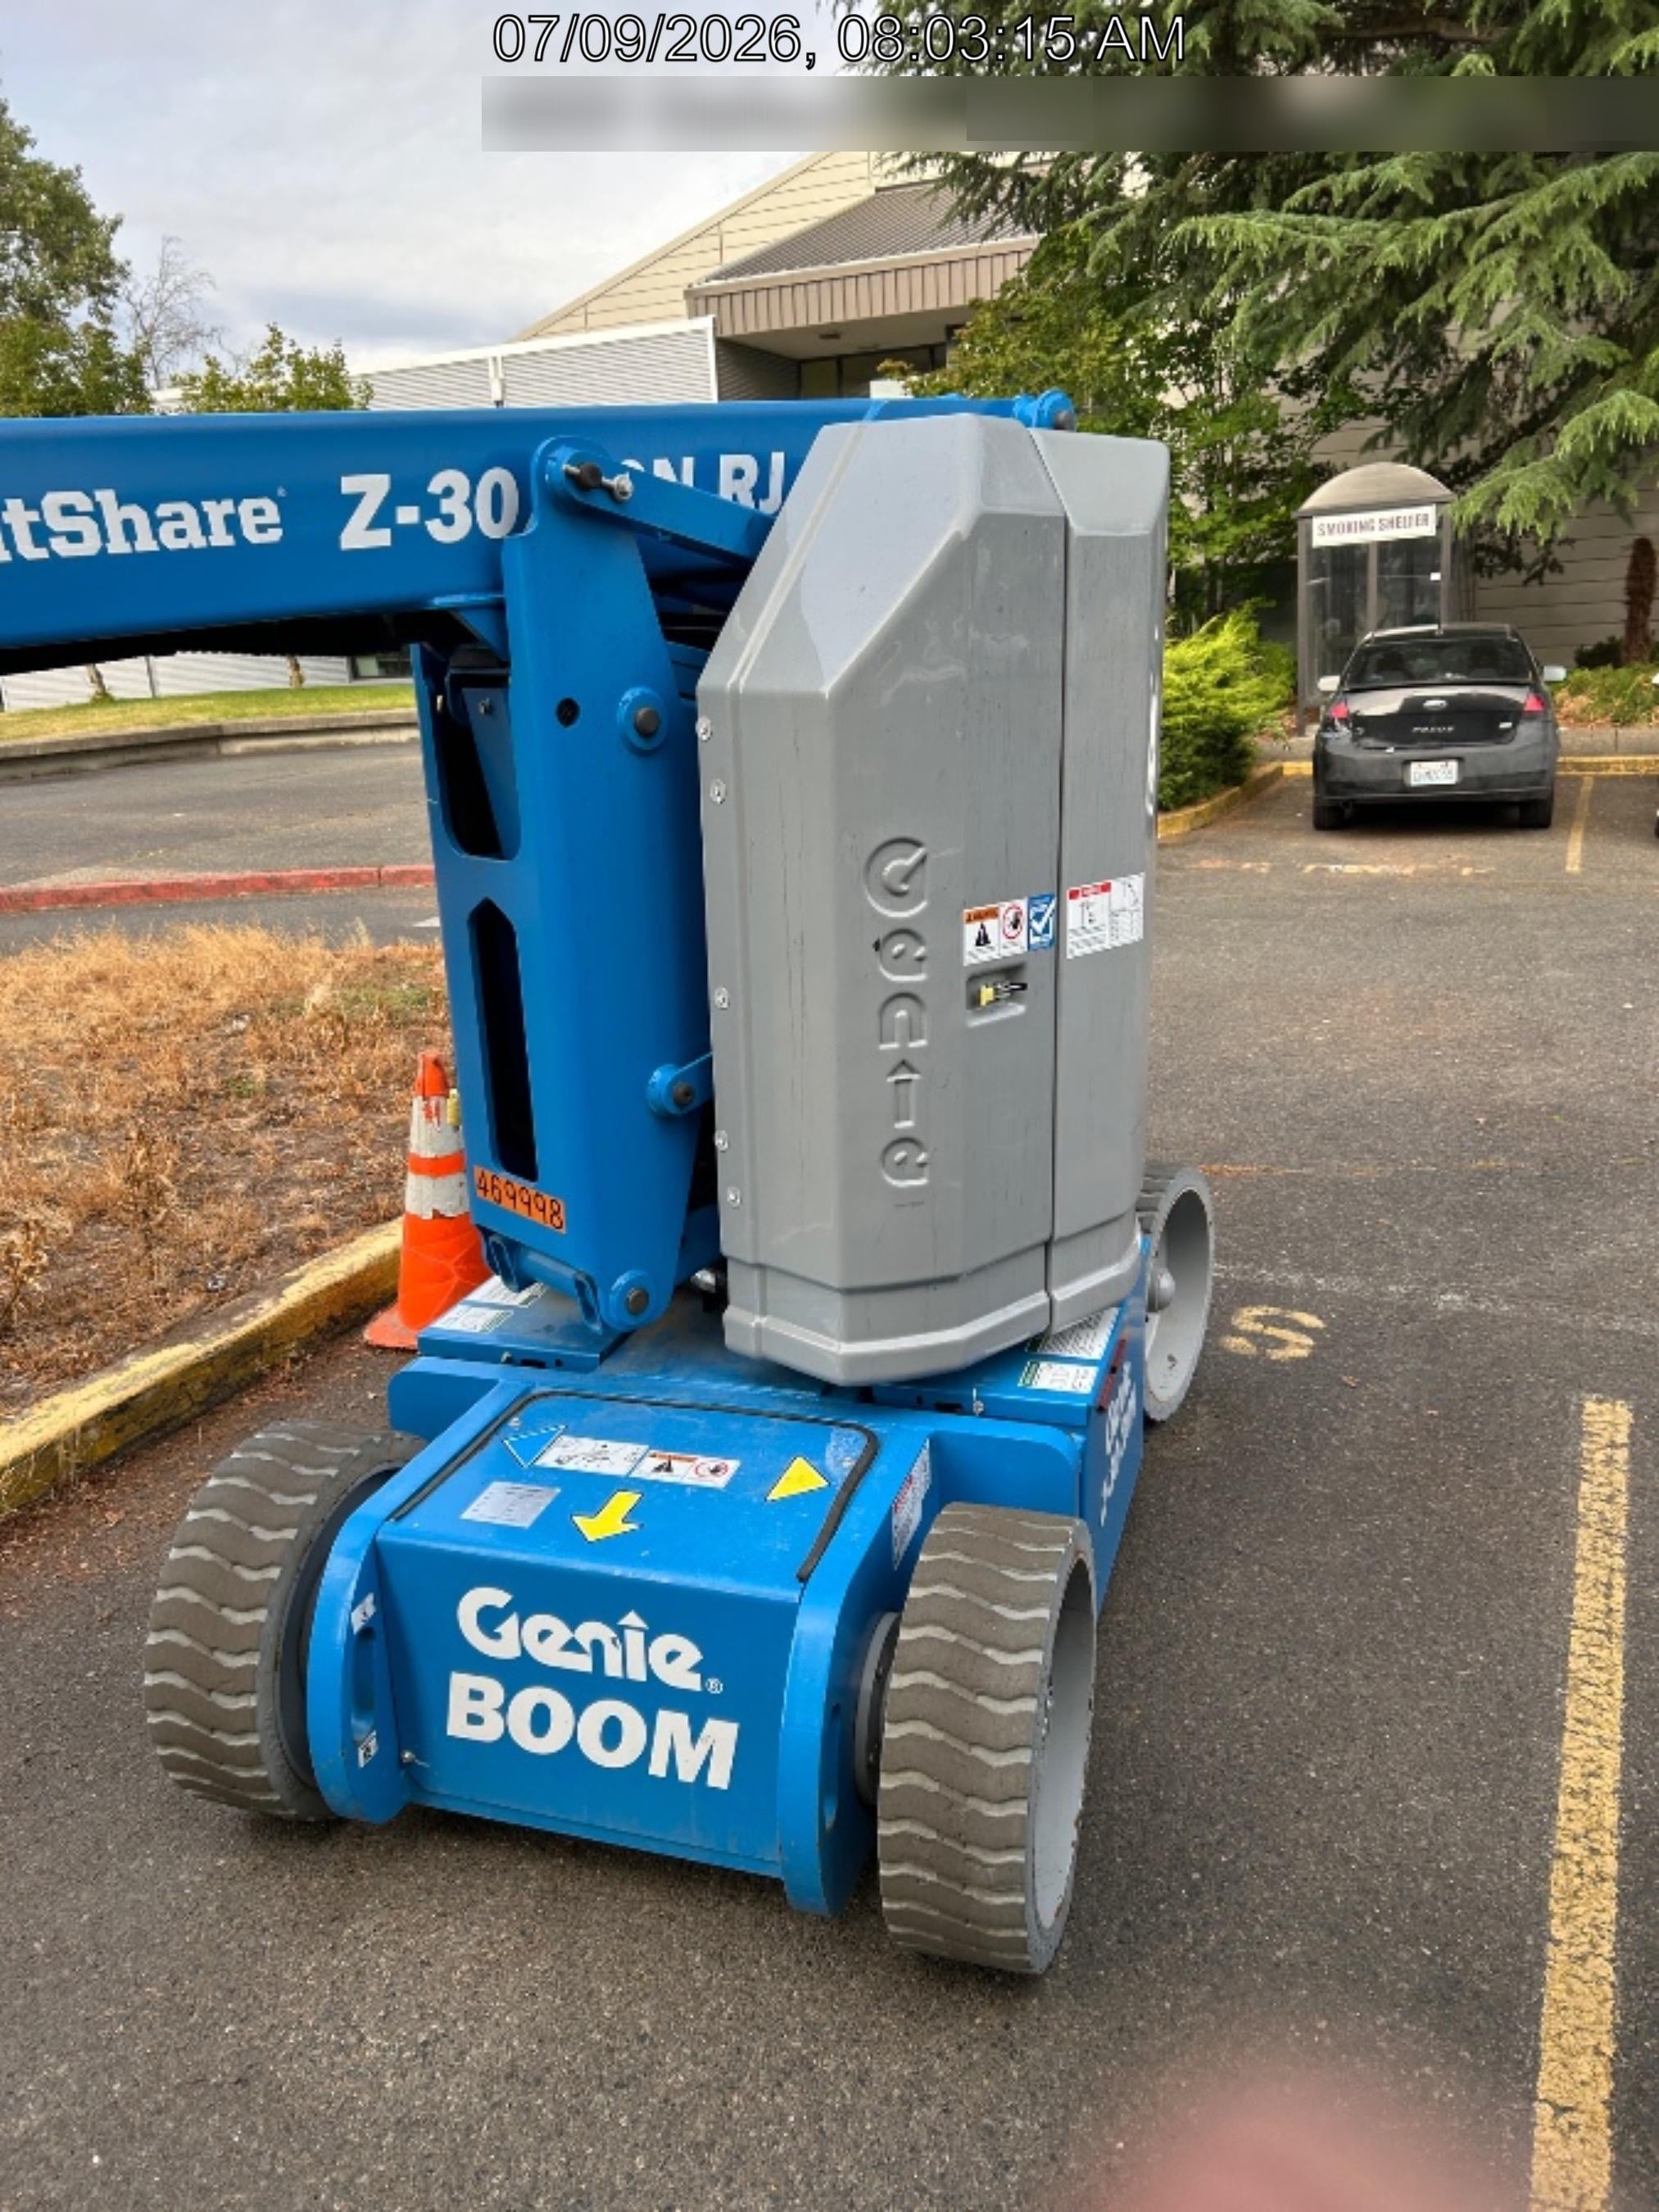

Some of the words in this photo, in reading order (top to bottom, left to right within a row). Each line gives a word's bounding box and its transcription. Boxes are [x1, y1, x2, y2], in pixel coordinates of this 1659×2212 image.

[340, 468, 519, 551] Z-30
[718, 451, 786, 514] RJ
[1317, 519, 1376, 537] SMOKING
[1378, 513, 1429, 532] SHELTER
[476, 1169, 565, 1230] 469998
[446, 1671, 739, 1790] BOOM
